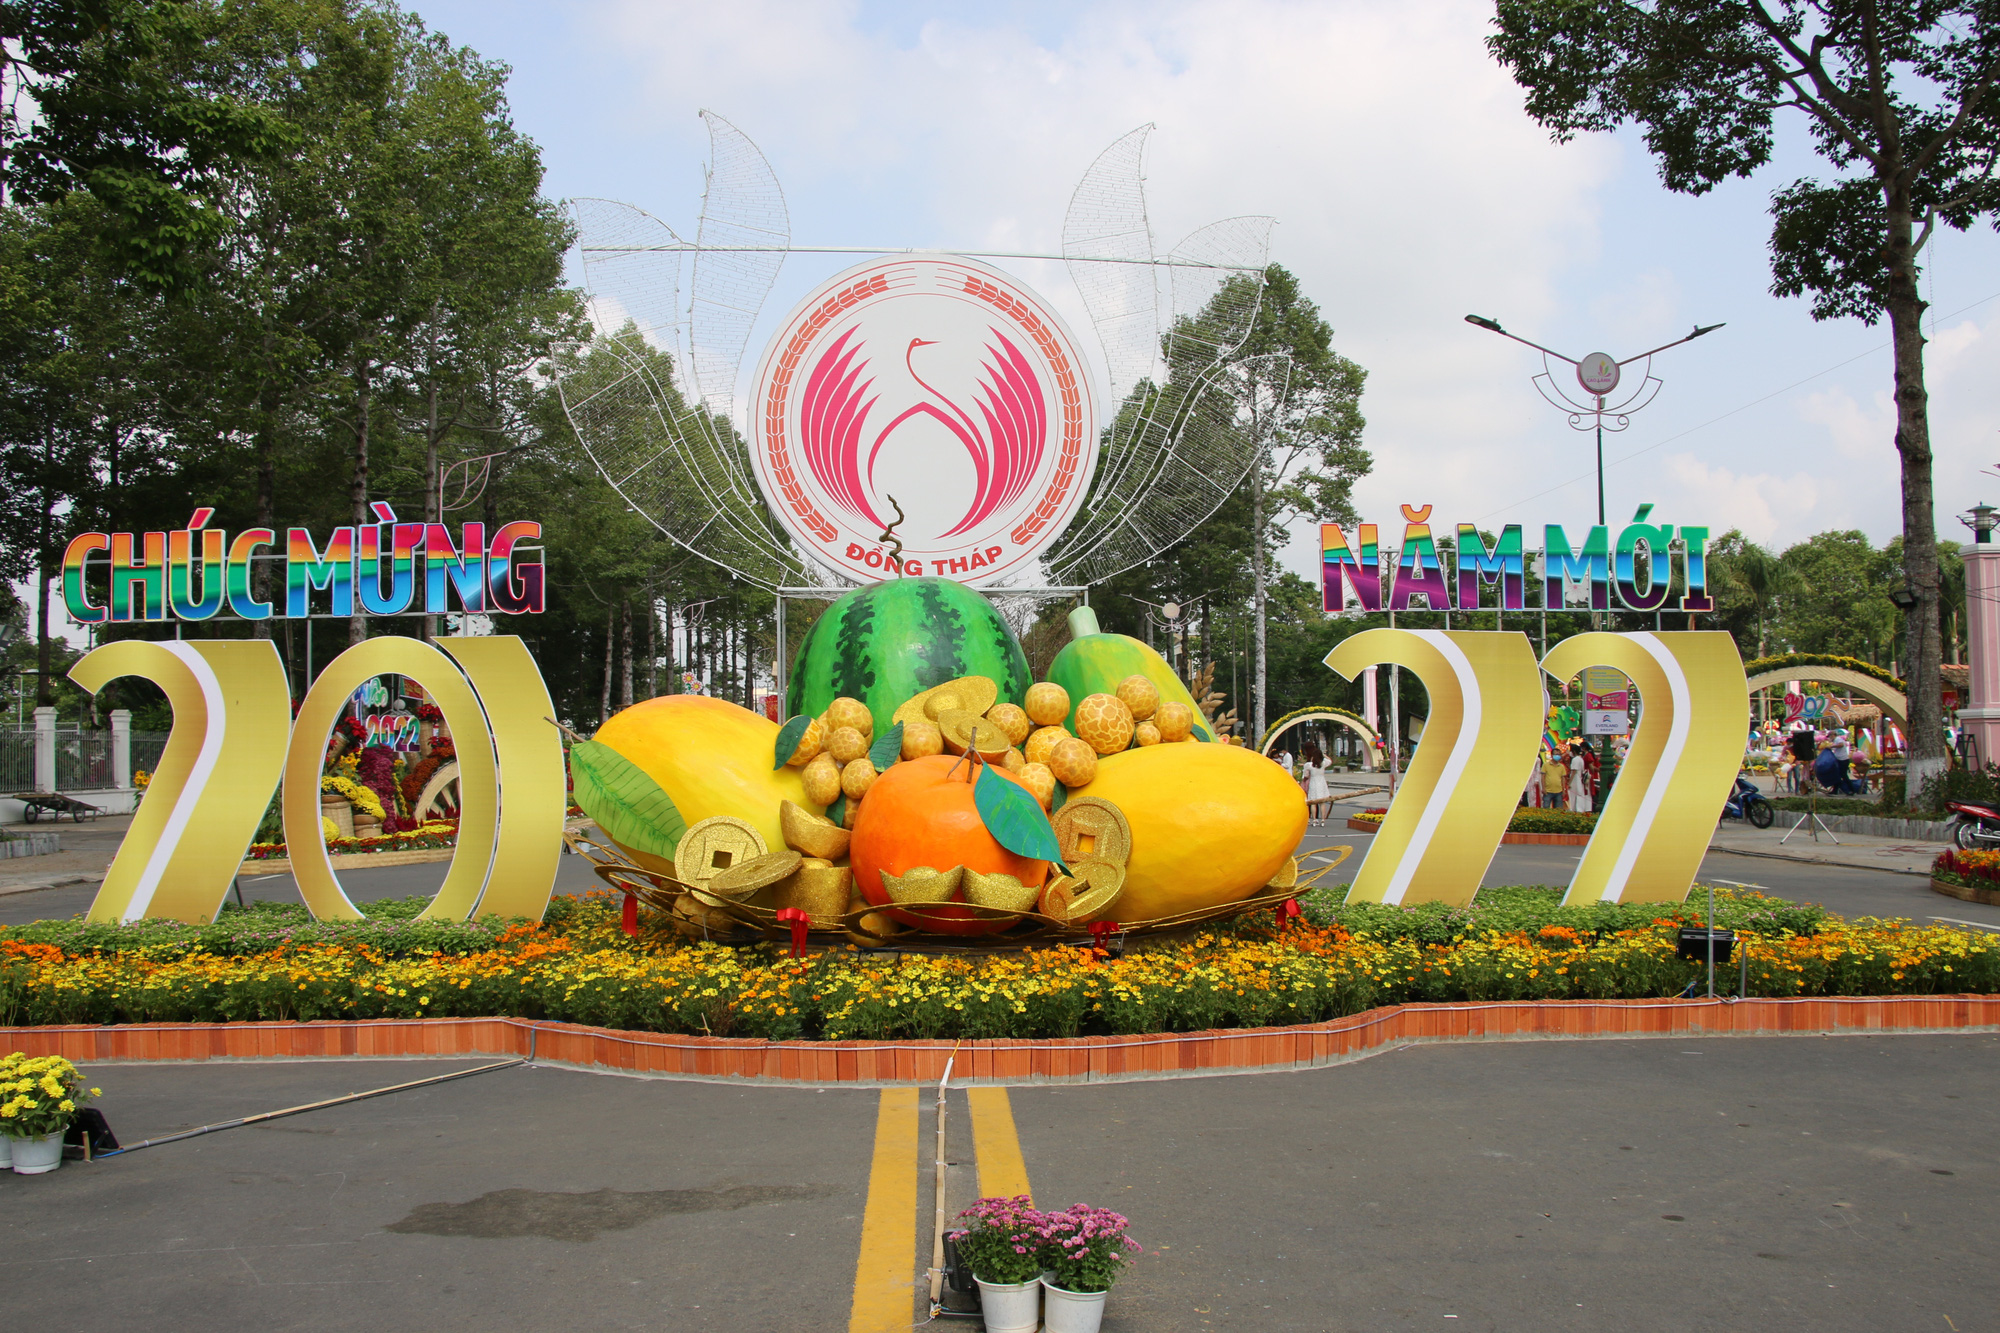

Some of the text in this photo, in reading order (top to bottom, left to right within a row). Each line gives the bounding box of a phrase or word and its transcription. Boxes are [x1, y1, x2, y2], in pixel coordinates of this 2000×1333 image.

[61, 500, 546, 624] CHÚC MỪNG
[845, 542, 1003, 577] ĐỒNG THÁP
[1319, 503, 1714, 612] NĂM MỚI
[366, 714, 420, 752] 2022
